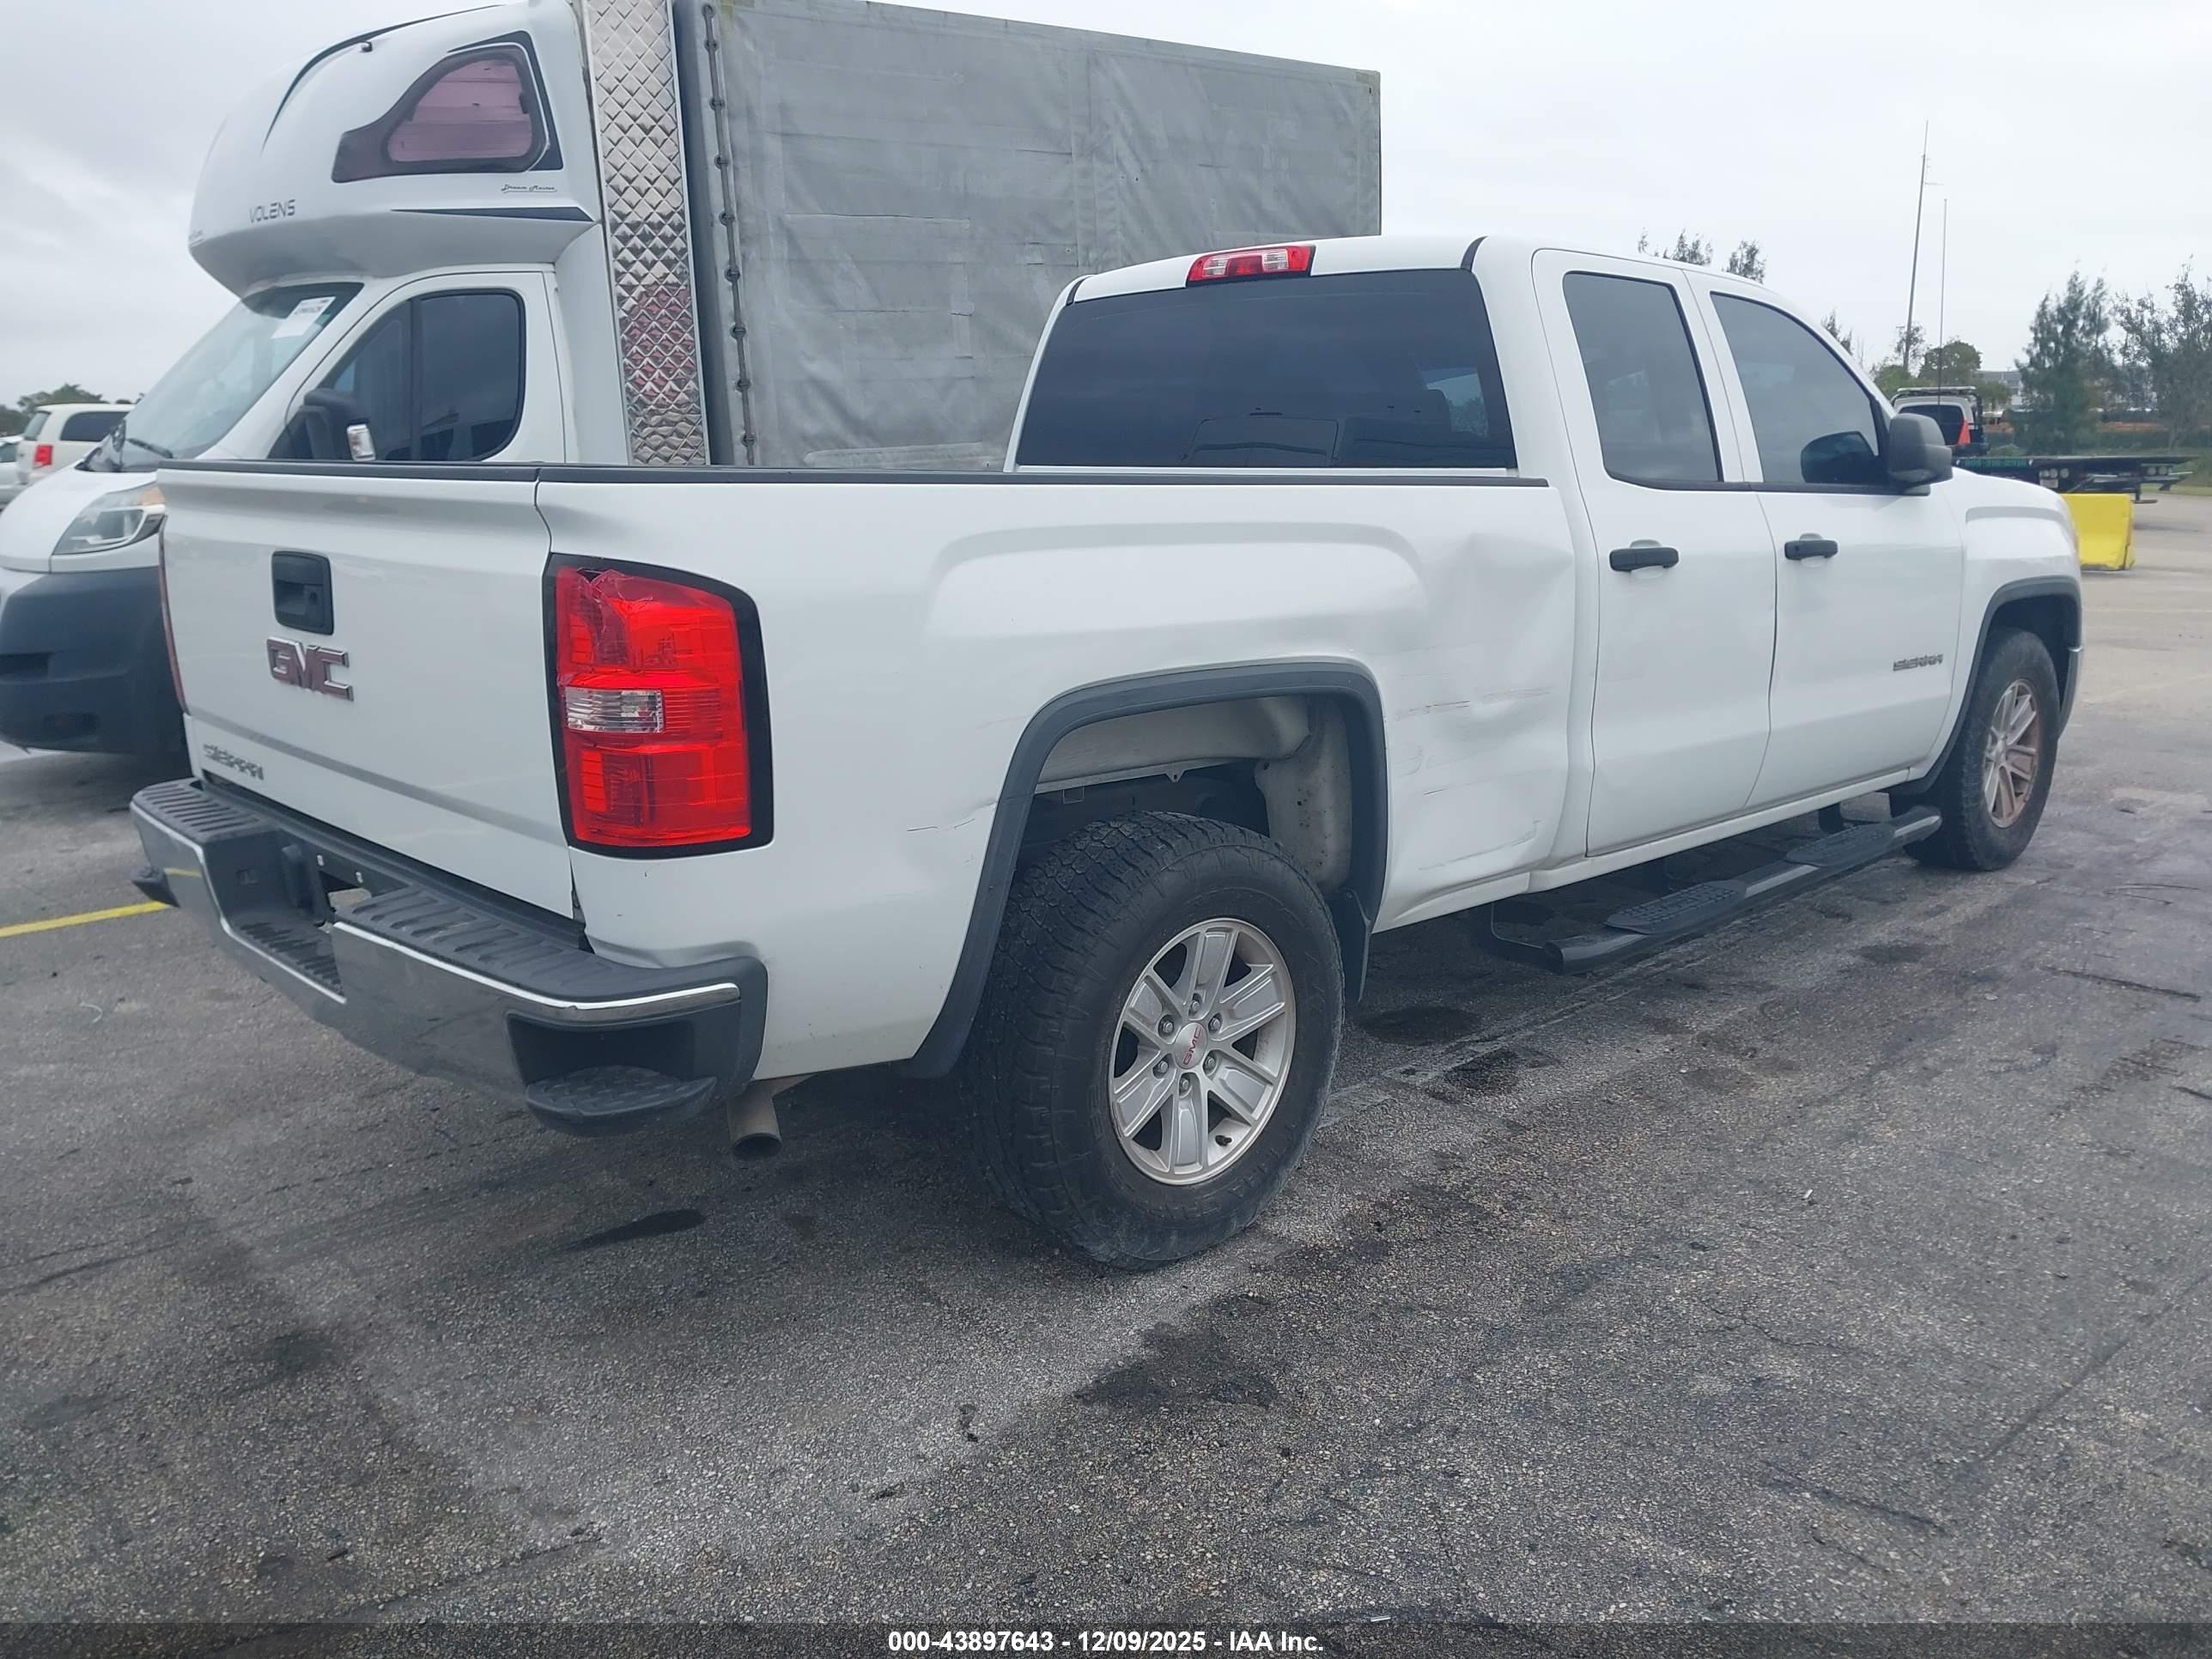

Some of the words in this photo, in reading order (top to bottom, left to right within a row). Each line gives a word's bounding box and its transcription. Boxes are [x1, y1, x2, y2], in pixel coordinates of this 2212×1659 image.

[249, 198, 296, 223] VOLENS
[267, 636, 354, 702] GMC
[1182, 1024, 1201, 1066] GMC
